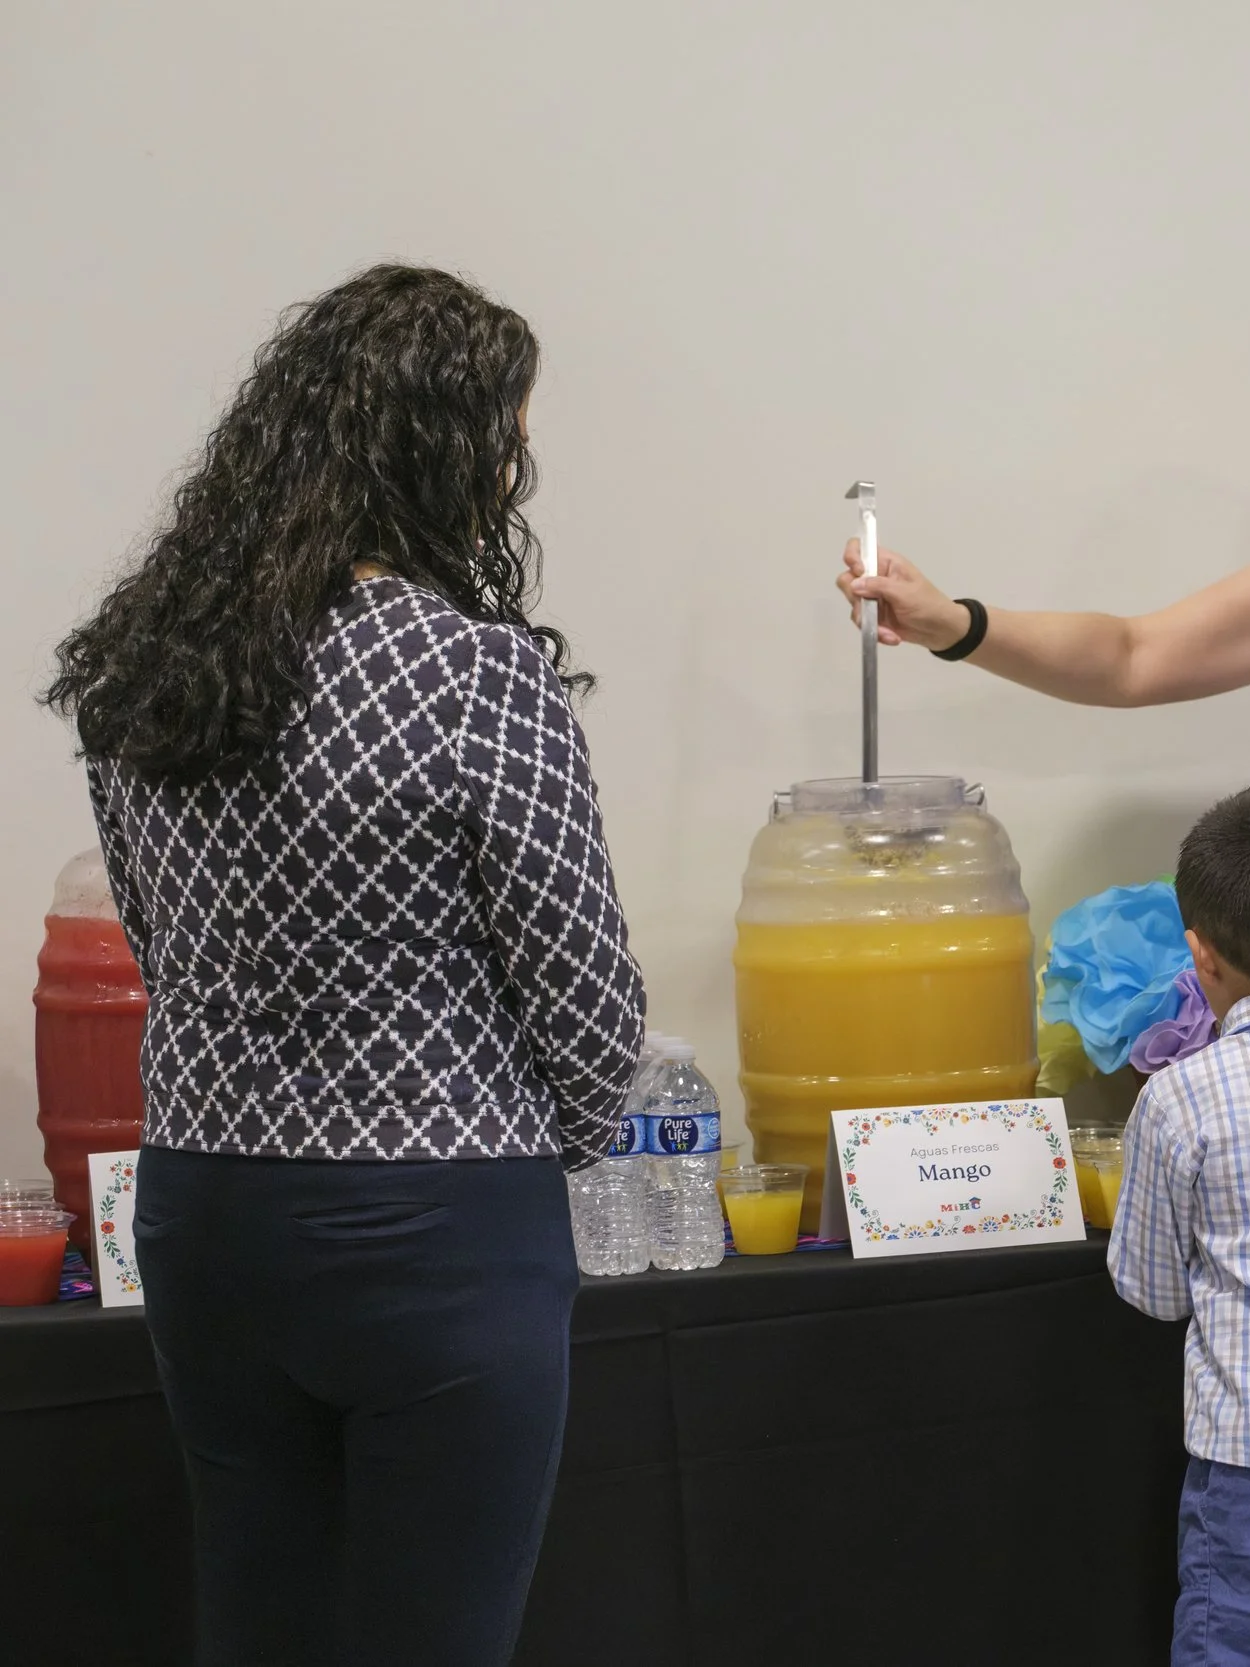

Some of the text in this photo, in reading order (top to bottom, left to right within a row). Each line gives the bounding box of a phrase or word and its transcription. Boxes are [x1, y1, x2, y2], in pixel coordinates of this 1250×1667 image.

[619, 1120, 631, 1130] re
[664, 1118, 692, 1129] Pure
[617, 1131, 629, 1144] fe
[667, 1129, 690, 1143] Life
[910, 1143, 1000, 1160] Aguas Frescas
[918, 1164, 991, 1183] Mango
